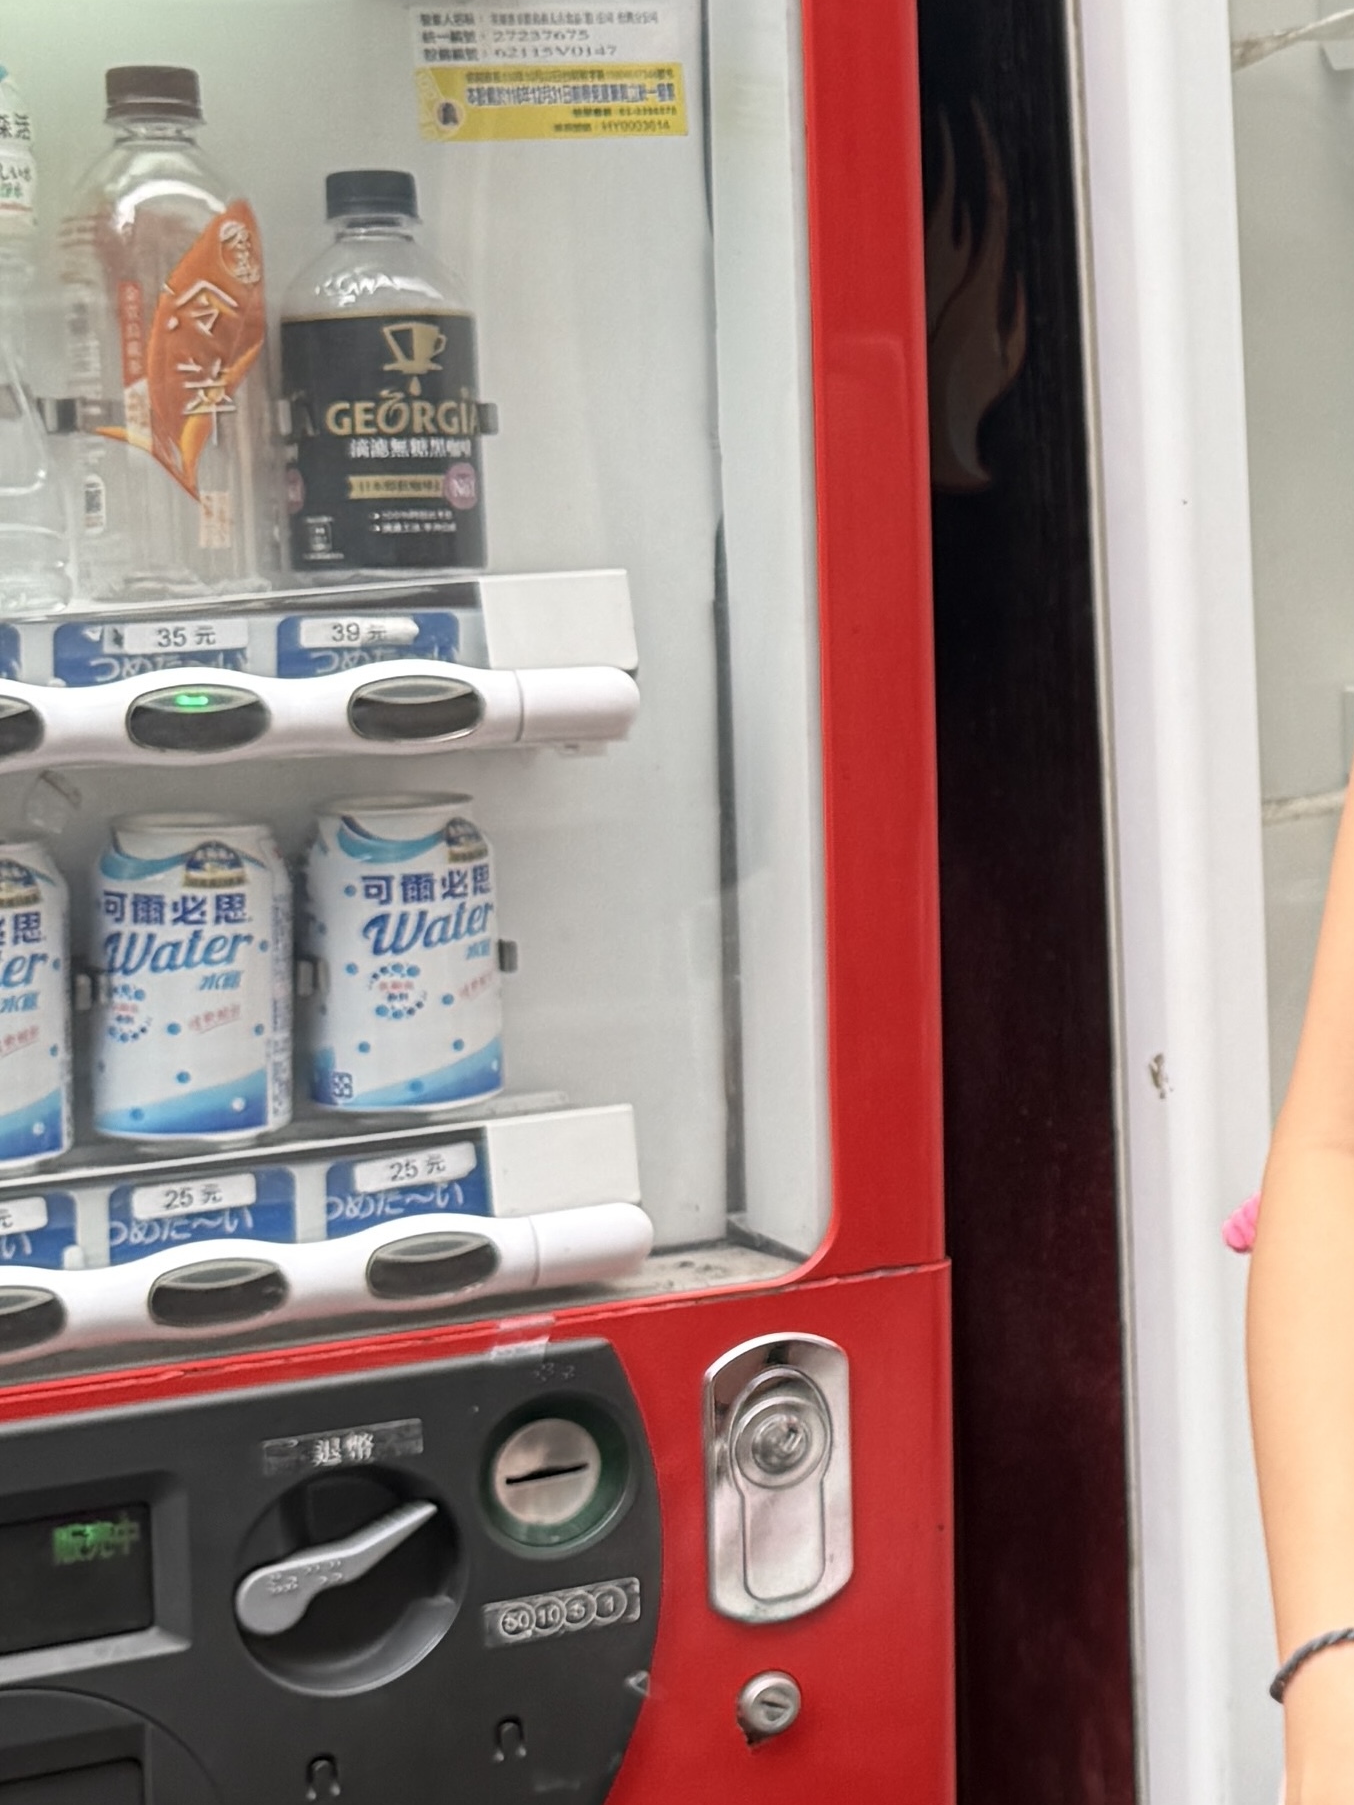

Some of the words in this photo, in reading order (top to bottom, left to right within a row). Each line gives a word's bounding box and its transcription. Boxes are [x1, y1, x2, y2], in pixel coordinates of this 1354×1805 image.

[157, 626, 187, 648] 35
[195, 626, 216, 645] 元
[332, 622, 360, 642] 39
[366, 624, 387, 641] 元
[360, 863, 491, 906] 可爾必思
[101, 889, 248, 926] 可爾必思
[362, 900, 494, 957] Water
[0, 952, 49, 988] er
[102, 929, 254, 977] Water
[390, 1159, 419, 1182] 25
[426, 1153, 447, 1175] 元
[164, 1188, 194, 1210] 25
[201, 1184, 222, 1204] 元
